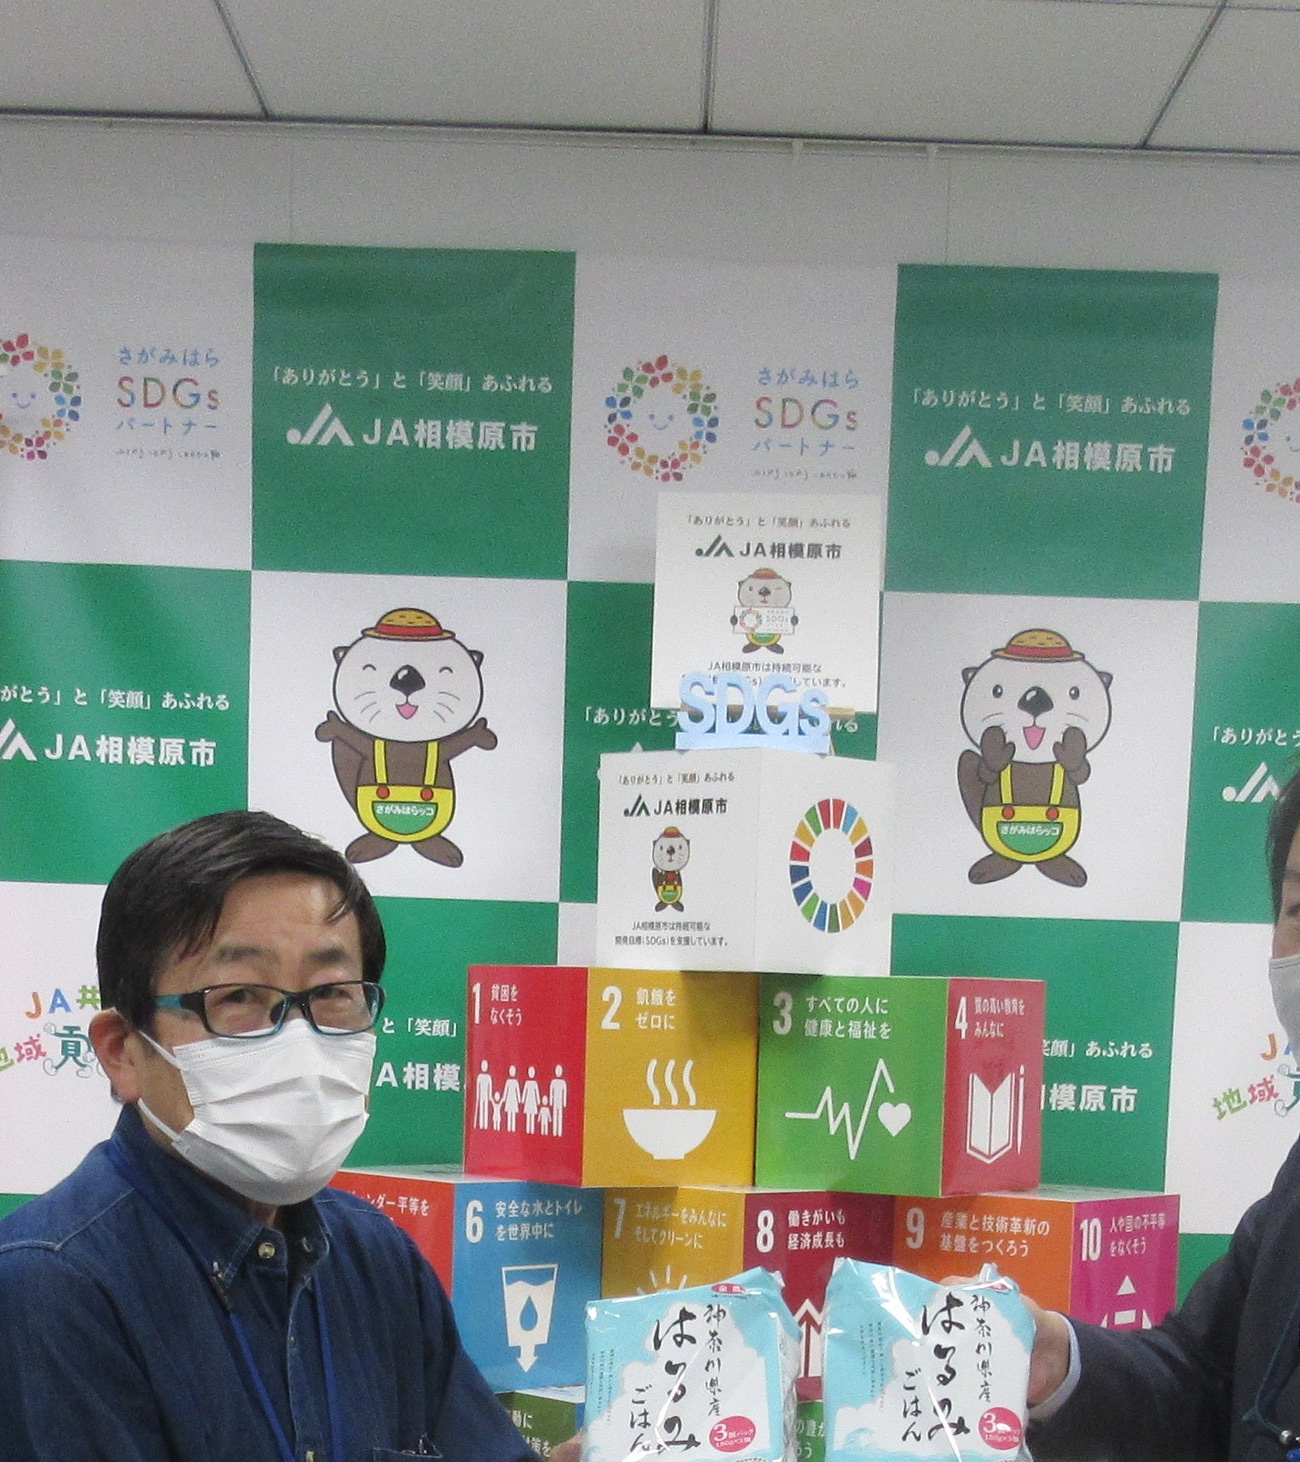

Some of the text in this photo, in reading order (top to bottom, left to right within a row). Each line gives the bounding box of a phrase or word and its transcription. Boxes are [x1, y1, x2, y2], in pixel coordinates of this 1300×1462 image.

[117, 346, 220, 368] さがみはら
[271, 366, 554, 395] 「ありがとう」と「笑顔」あふれる
[757, 365, 860, 390] さがみはら
[116, 375, 220, 411] SDGs
[911, 387, 1192, 416] 「ありがとう」と「笑顔」あふれる
[754, 395, 860, 432] SDGs
[116, 416, 218, 436] パートナー
[362, 417, 539, 452] JA相模原市
[751, 436, 856, 457] パートナー
[1000, 438, 1177, 475] JA相模原市
[740, 541, 842, 560] JA相模原市
[677, 671, 831, 737] SDGs
[44, 734, 218, 768] JA相模原市
[654, 797, 728, 816] JA相模原市
[473, 982, 482, 1025] 1
[491, 984, 519, 1003] 貧困を
[636, 988, 677, 1007] 飢餓を
[805, 996, 889, 1015] すべての人に
[490, 1008, 523, 1027] なくそう
[601, 985, 623, 1031] 2
[773, 991, 792, 1036] 3
[955, 996, 968, 1040] 4
[636, 1011, 676, 1031] ゼロに
[804, 1019, 892, 1040] 健康と福祉を
[974, 1021, 1005, 1038] みんなに
[465, 1200, 484, 1243] 6
[495, 1200, 584, 1220] 安全な水とトイレ
[613, 1198, 626, 1239] 7
[635, 1204, 727, 1228] エネルギーをみんなに
[788, 1209, 846, 1227] 働きがいも
[495, 1223, 555, 1242] を世界中に
[756, 1210, 774, 1253] 8
[906, 1208, 925, 1250] 9
[940, 1213, 1050, 1237] 産業と技術革新の
[1110, 1215, 1166, 1233] 人や国の不平等
[787, 1232, 845, 1249] 経済成長も
[940, 1234, 1029, 1258] 基盤をつくろう
[1079, 1218, 1101, 1261] 10
[1110, 1237, 1147, 1257] をなくそう
[902, 1367, 922, 1442] ごはん
